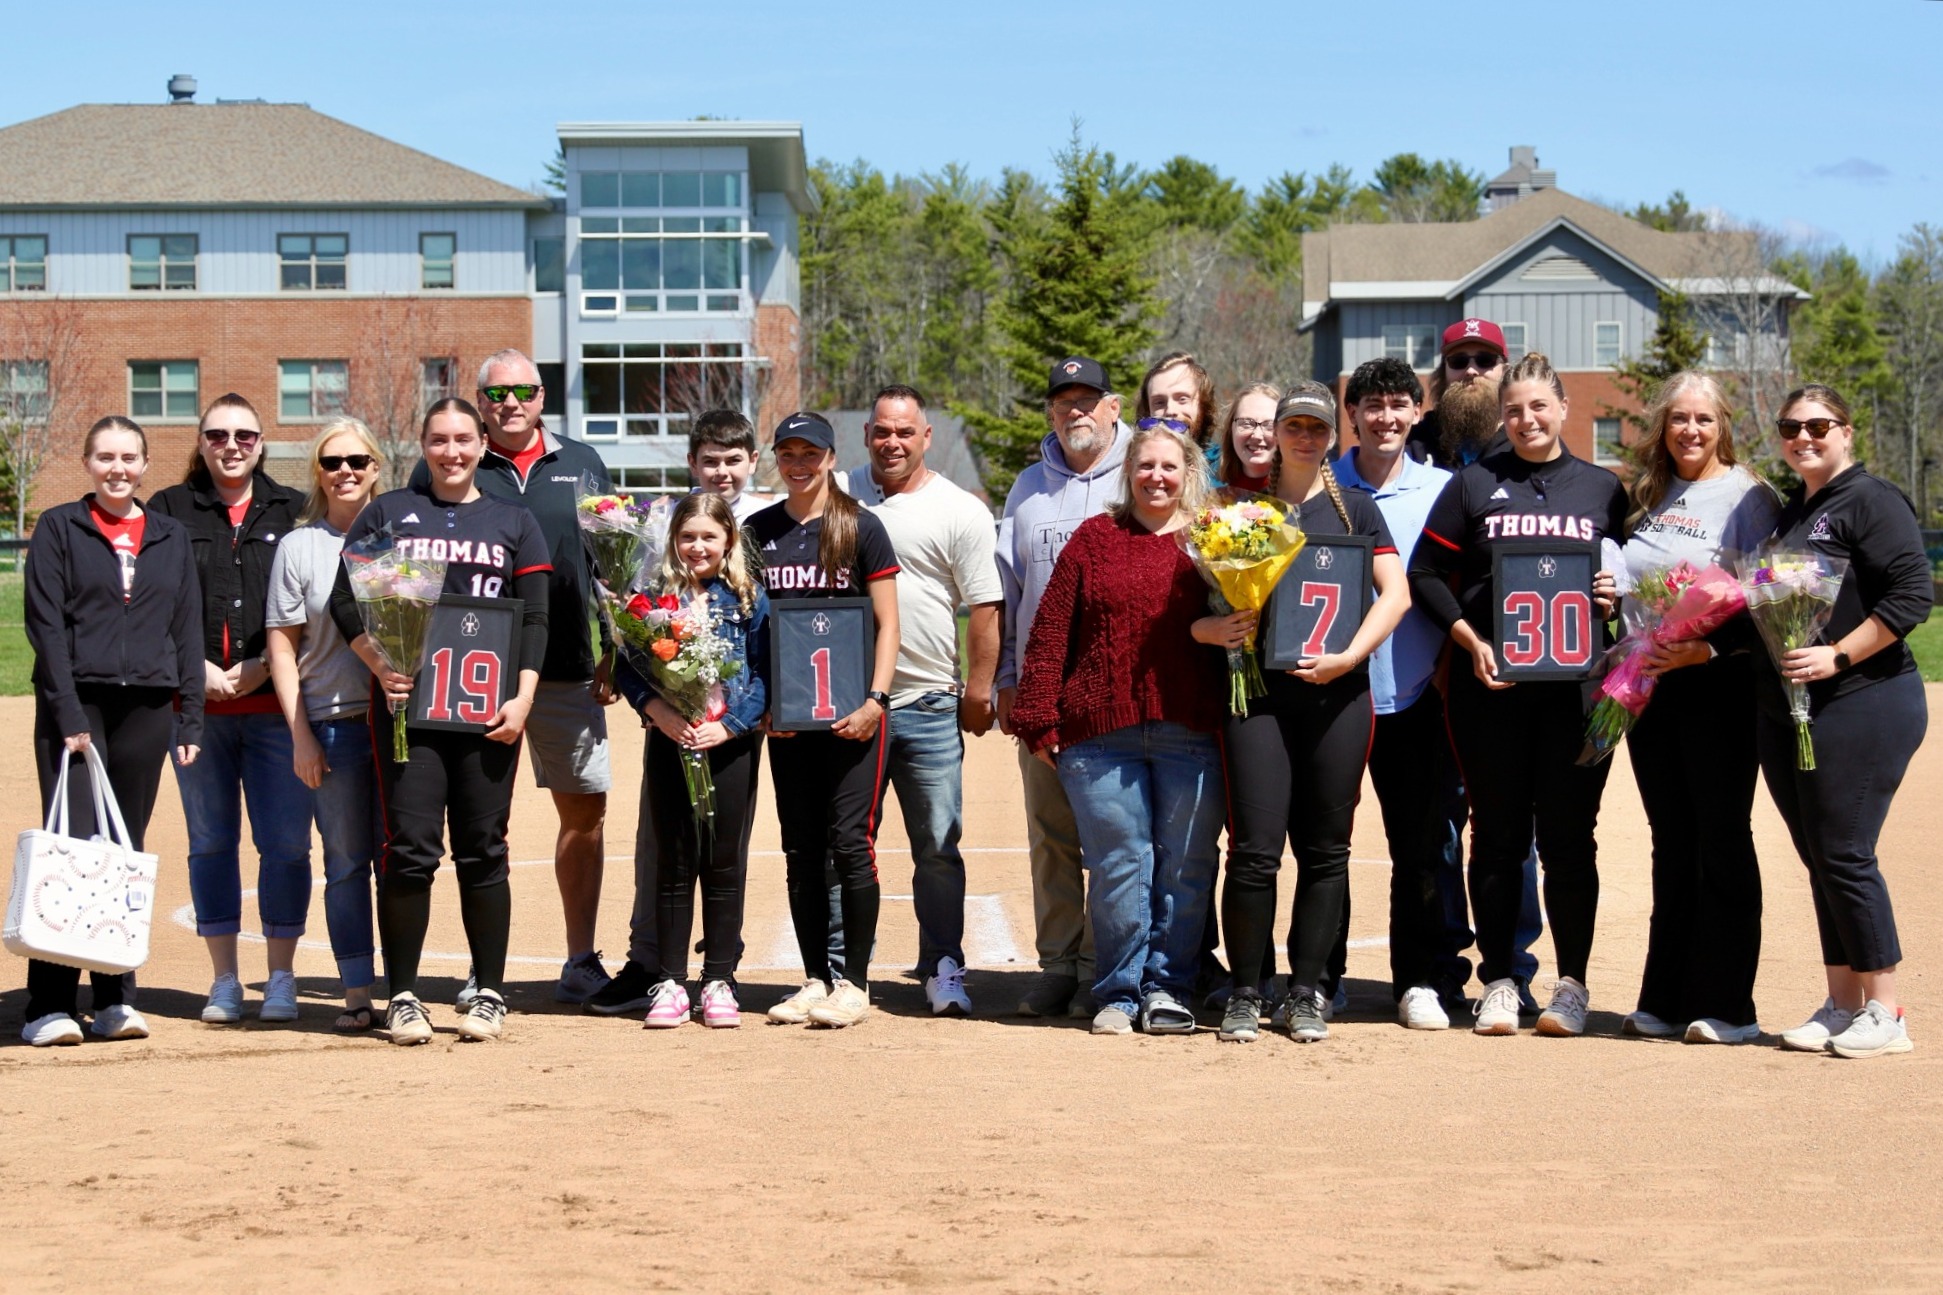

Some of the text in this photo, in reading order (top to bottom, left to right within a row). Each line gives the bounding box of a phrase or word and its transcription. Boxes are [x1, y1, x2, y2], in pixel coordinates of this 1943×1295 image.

[1040, 528, 1074, 544] Tho
[1484, 514, 1594, 541] THOMAS
[1656, 513, 1701, 528] THOMAS
[397, 538, 505, 568] THOMAS
[1300, 581, 1341, 658] 7
[1503, 591, 1592, 666] 30
[427, 648, 501, 724] 19
[810, 647, 836, 720] 1
